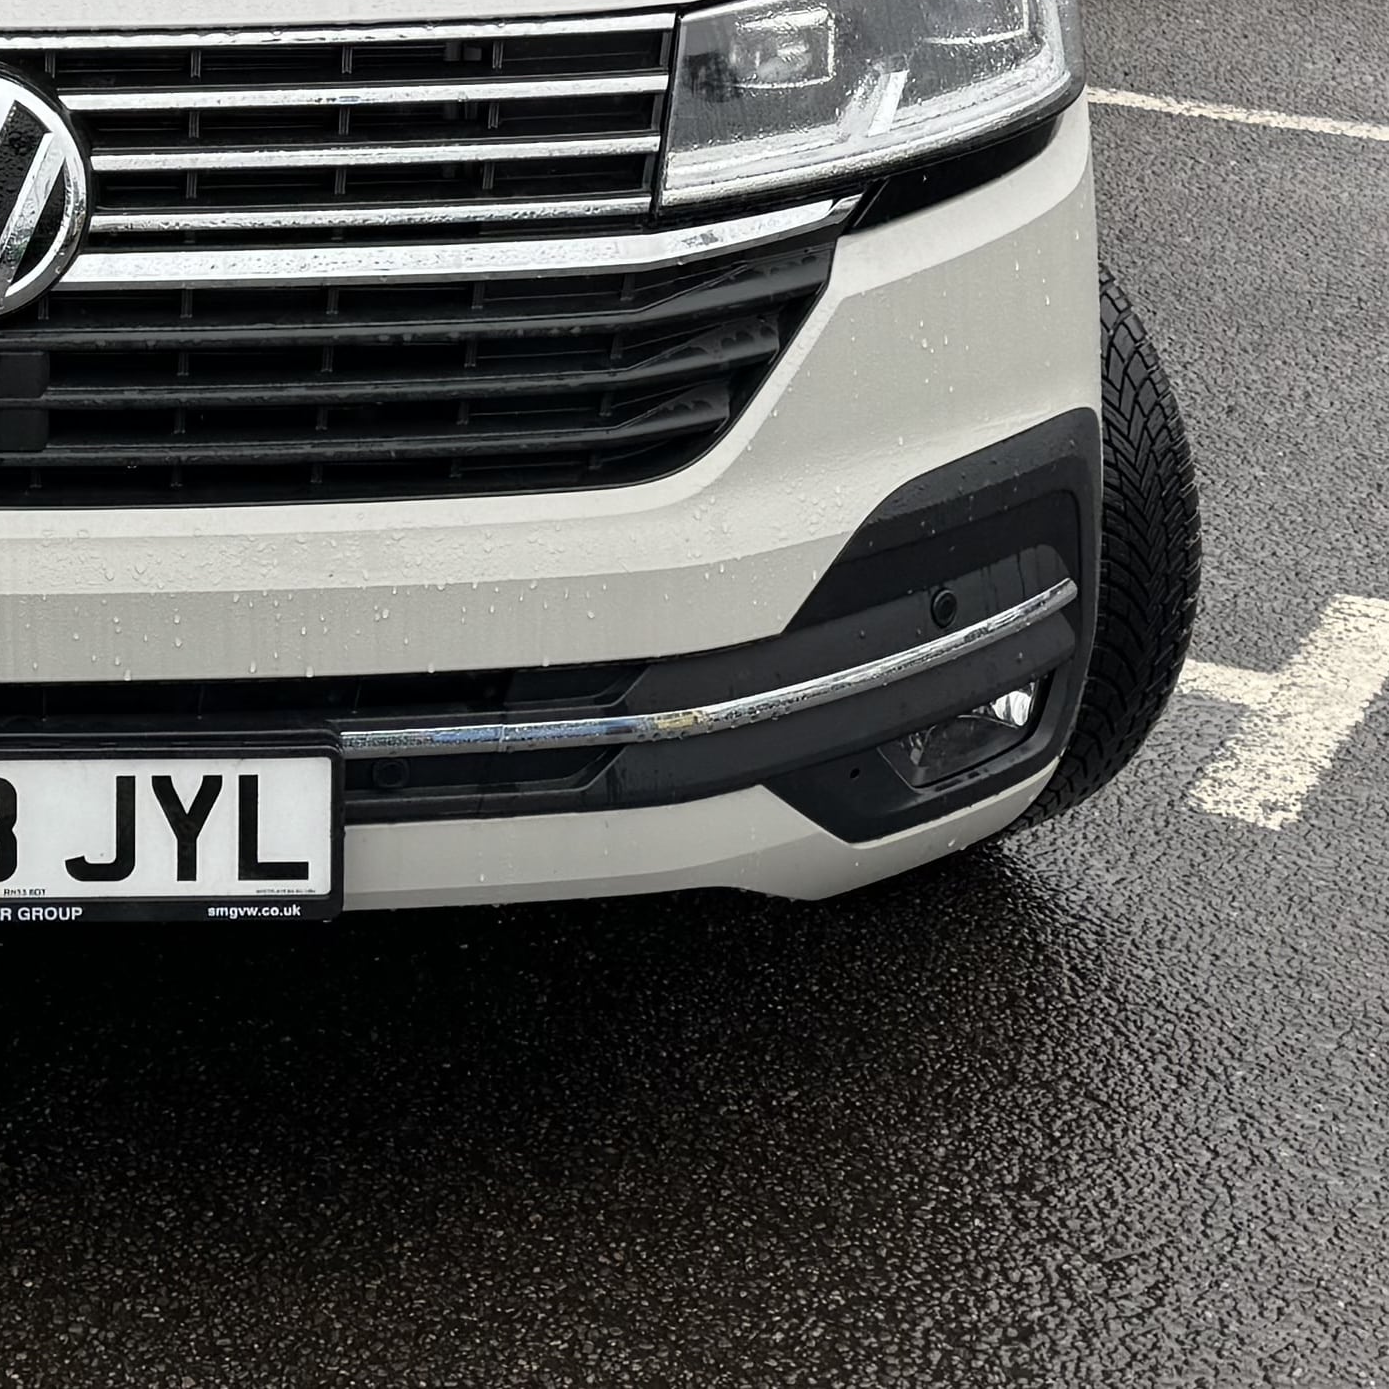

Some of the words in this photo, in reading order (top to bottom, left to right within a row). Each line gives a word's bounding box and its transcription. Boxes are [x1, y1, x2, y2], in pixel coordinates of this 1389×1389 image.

[64, 774, 310, 882] JYL
[17, 906, 83, 921] GROUP
[207, 903, 301, 920] smgvw.co.uk
